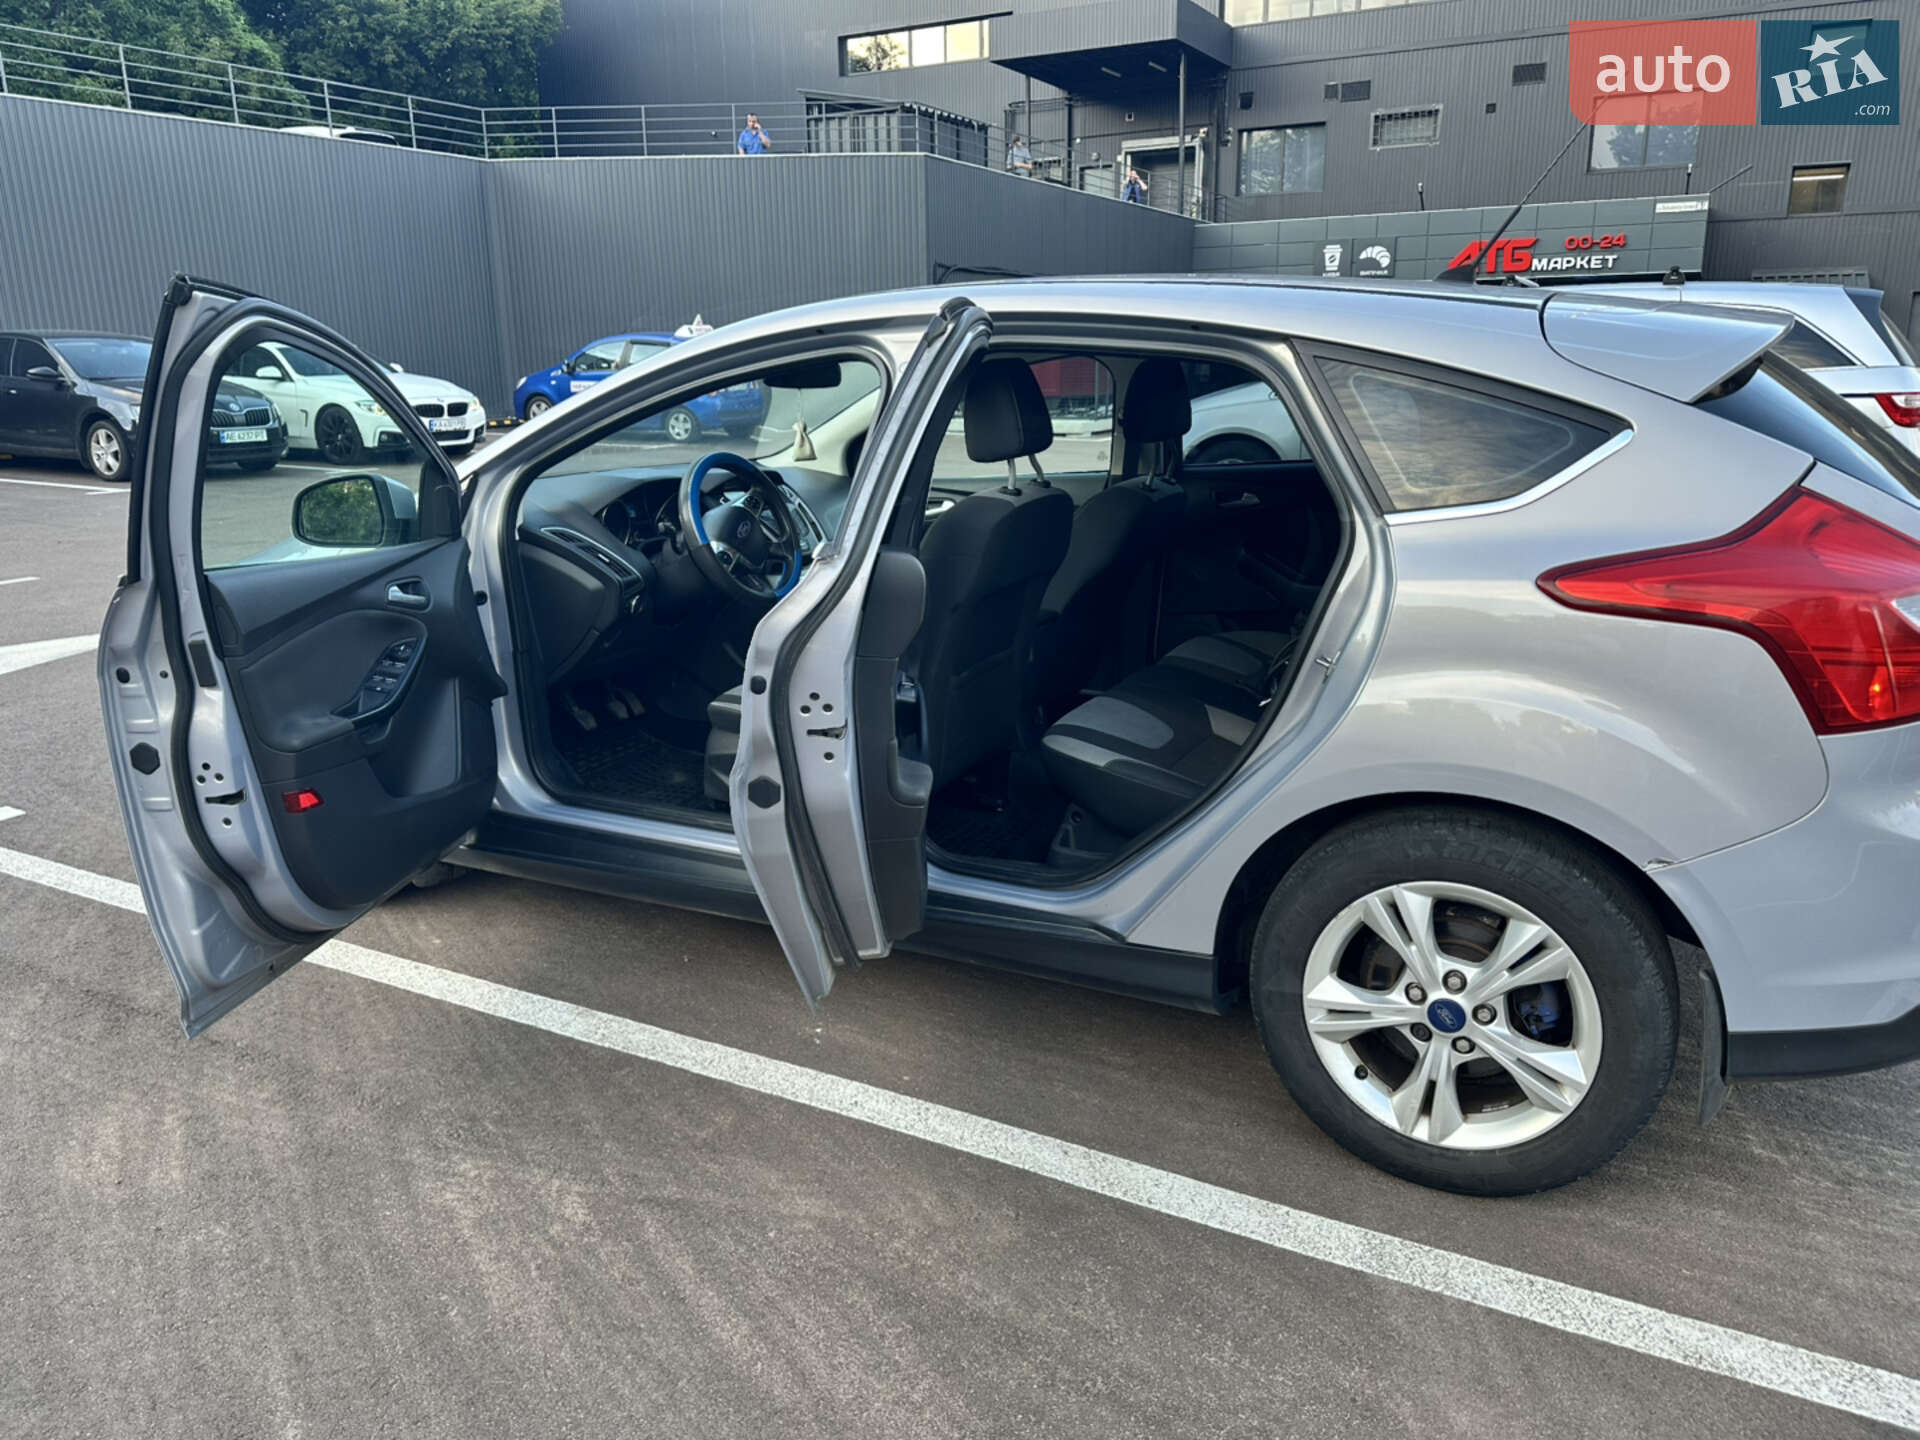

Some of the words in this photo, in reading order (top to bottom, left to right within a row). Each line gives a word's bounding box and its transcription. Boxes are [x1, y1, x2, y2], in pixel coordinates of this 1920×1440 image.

[1565, 233, 1626, 250] 00-24
[1448, 237, 1538, 273] АТБ
[1531, 255, 1617, 272] МАРКЕТ
